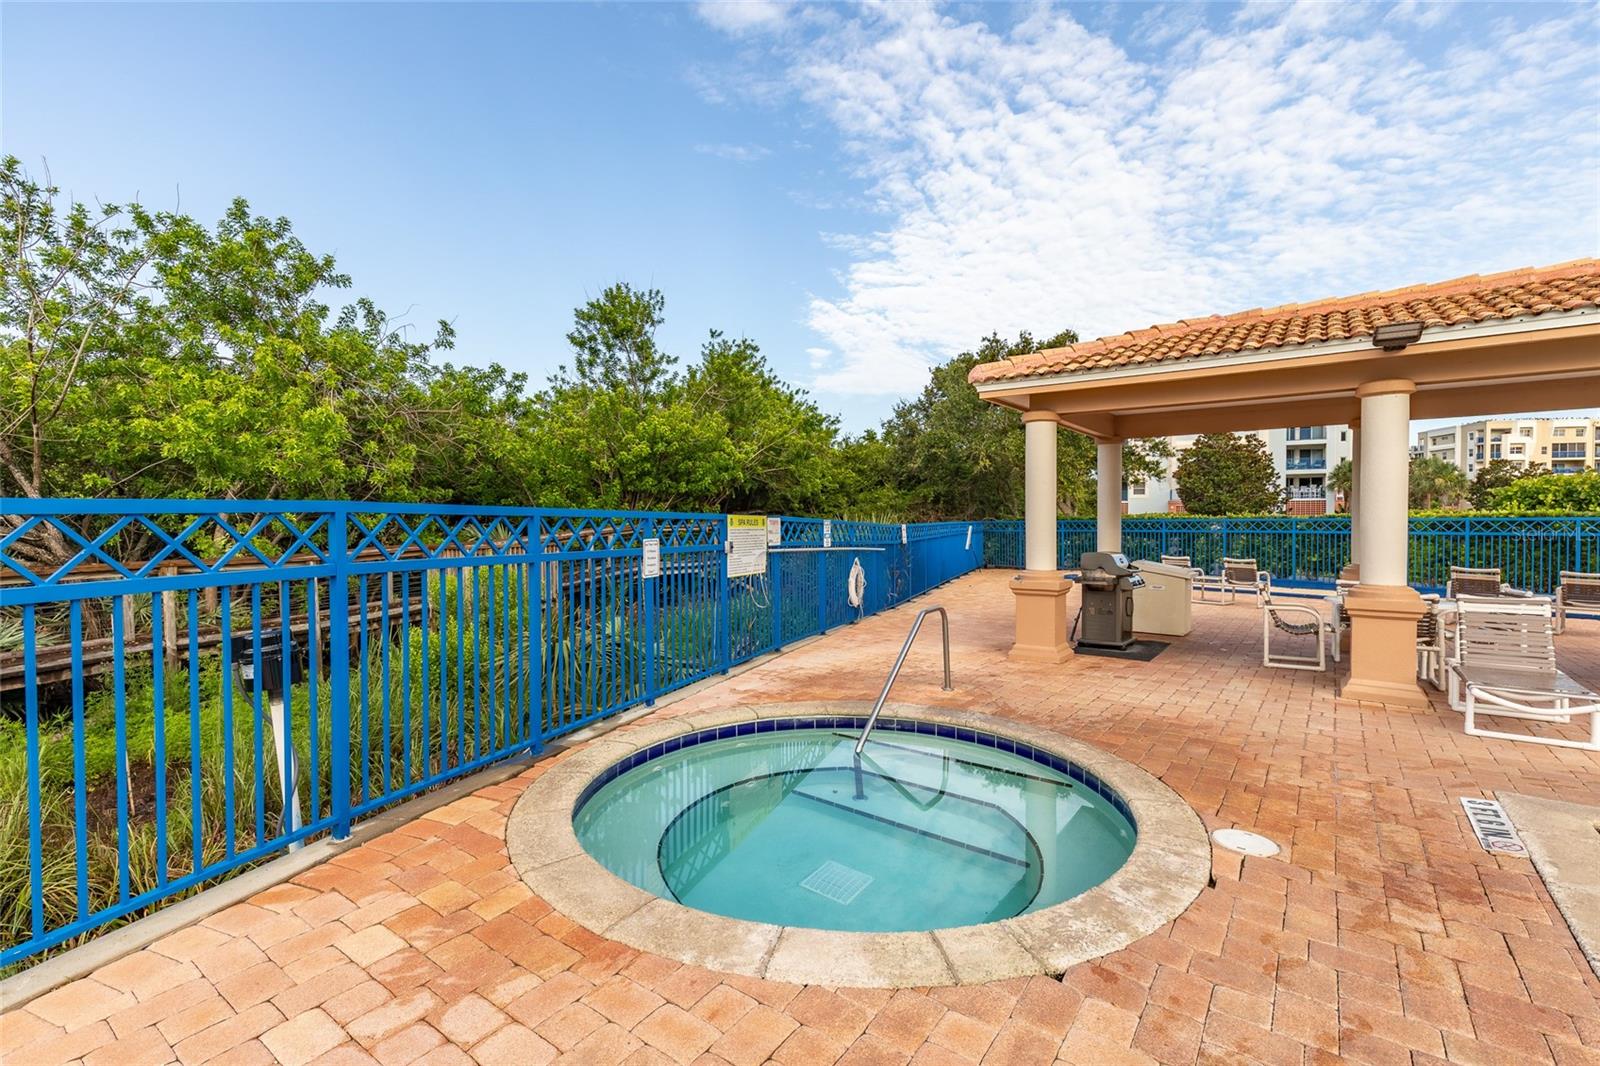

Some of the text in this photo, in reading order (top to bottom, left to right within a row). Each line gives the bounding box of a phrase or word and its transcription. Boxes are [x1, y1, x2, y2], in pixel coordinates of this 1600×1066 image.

[737, 518, 759, 526] SPA RULES
[1469, 806, 1502, 818] FT
